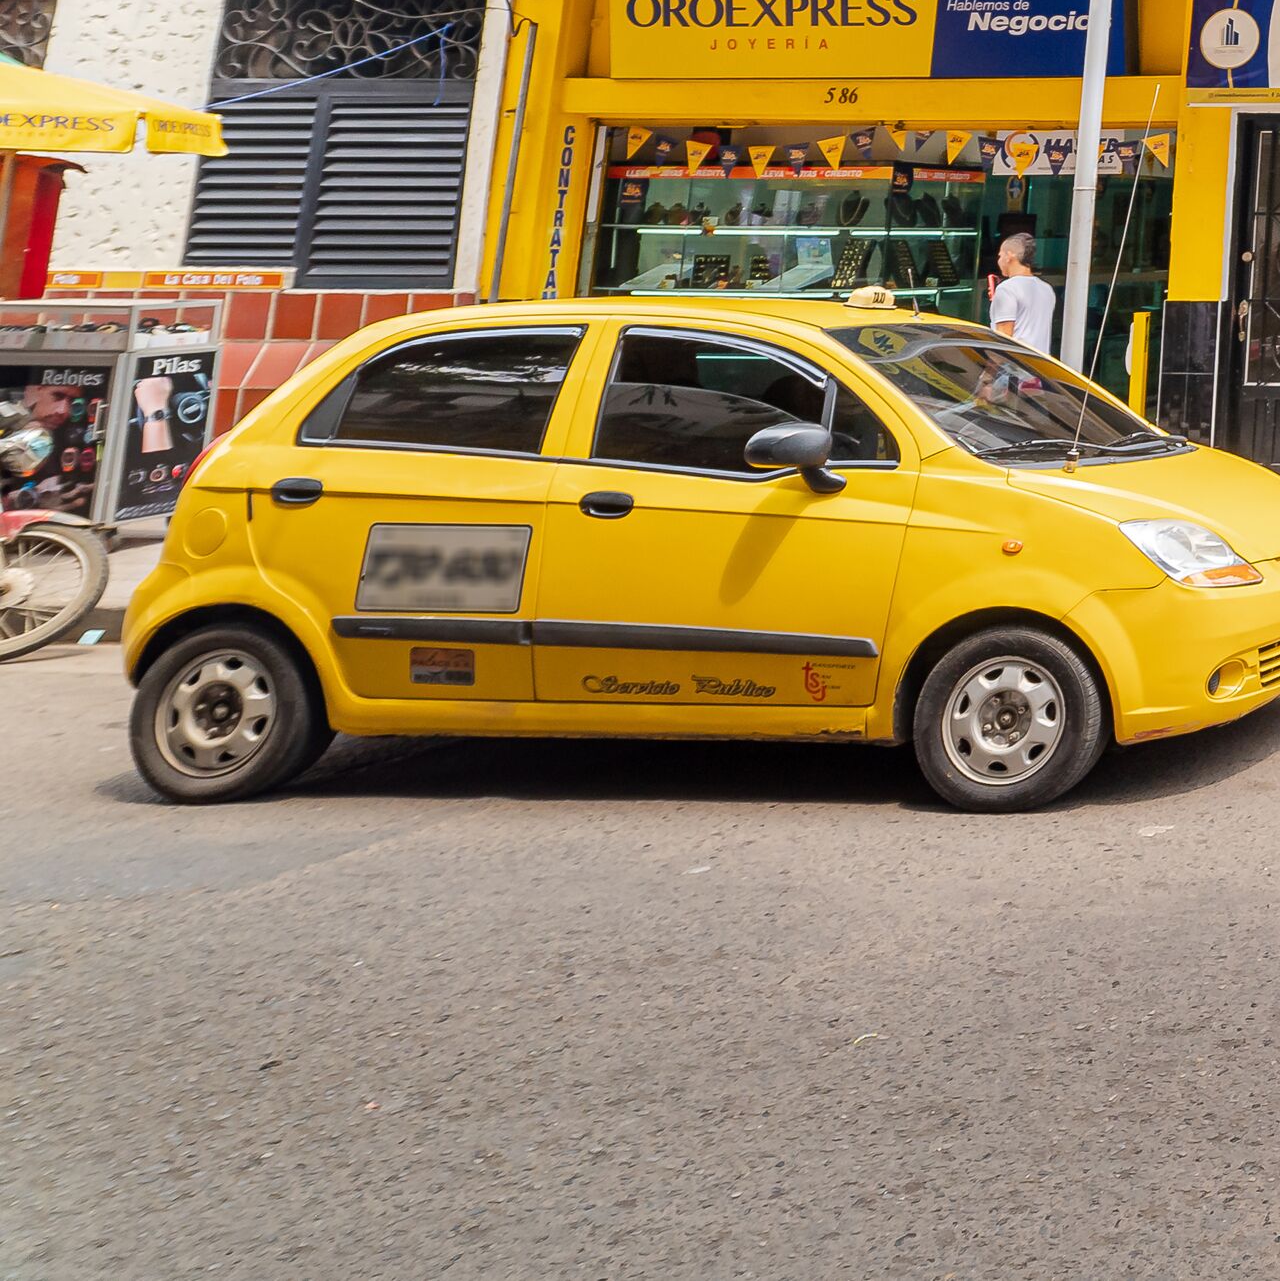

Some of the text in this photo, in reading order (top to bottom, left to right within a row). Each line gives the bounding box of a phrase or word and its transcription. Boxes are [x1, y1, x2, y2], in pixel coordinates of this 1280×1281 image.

[946, 0, 1030, 12] Hablemos de
[967, 11, 1112, 36] Negocio
[710, 35, 830, 52] JOYERÍA
[0, 113, 115, 132] EXPRESS
[152, 356, 202, 376] Pilas
[41, 369, 104, 388] Relojes
